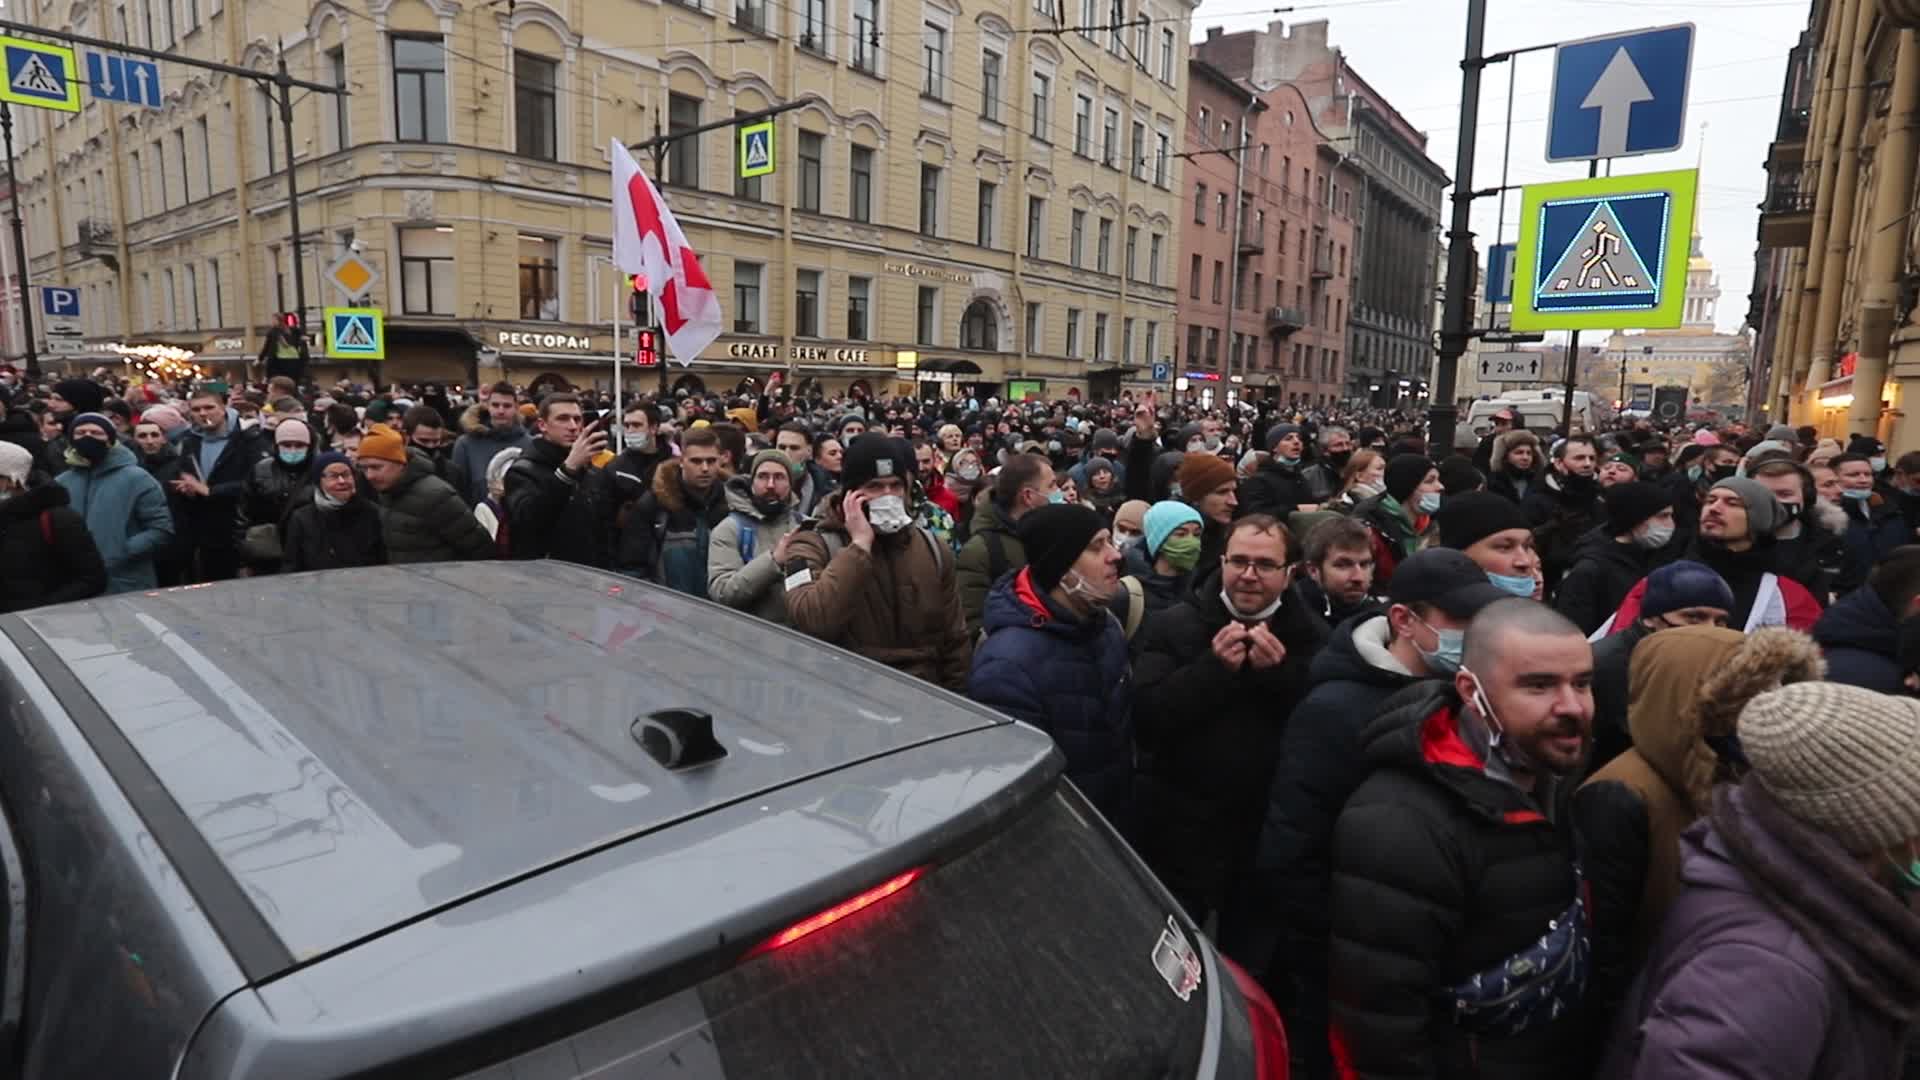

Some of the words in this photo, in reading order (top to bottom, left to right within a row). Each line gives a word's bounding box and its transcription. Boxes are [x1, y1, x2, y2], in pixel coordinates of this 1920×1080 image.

[52, 291, 72, 313] P
[499, 332, 589, 350] РЕСТОРАН
[729, 344, 778, 358] CRAFT
[790, 347, 828, 361] BREW
[836, 349, 868, 362] CAFE
[1155, 365, 1166, 379] P
